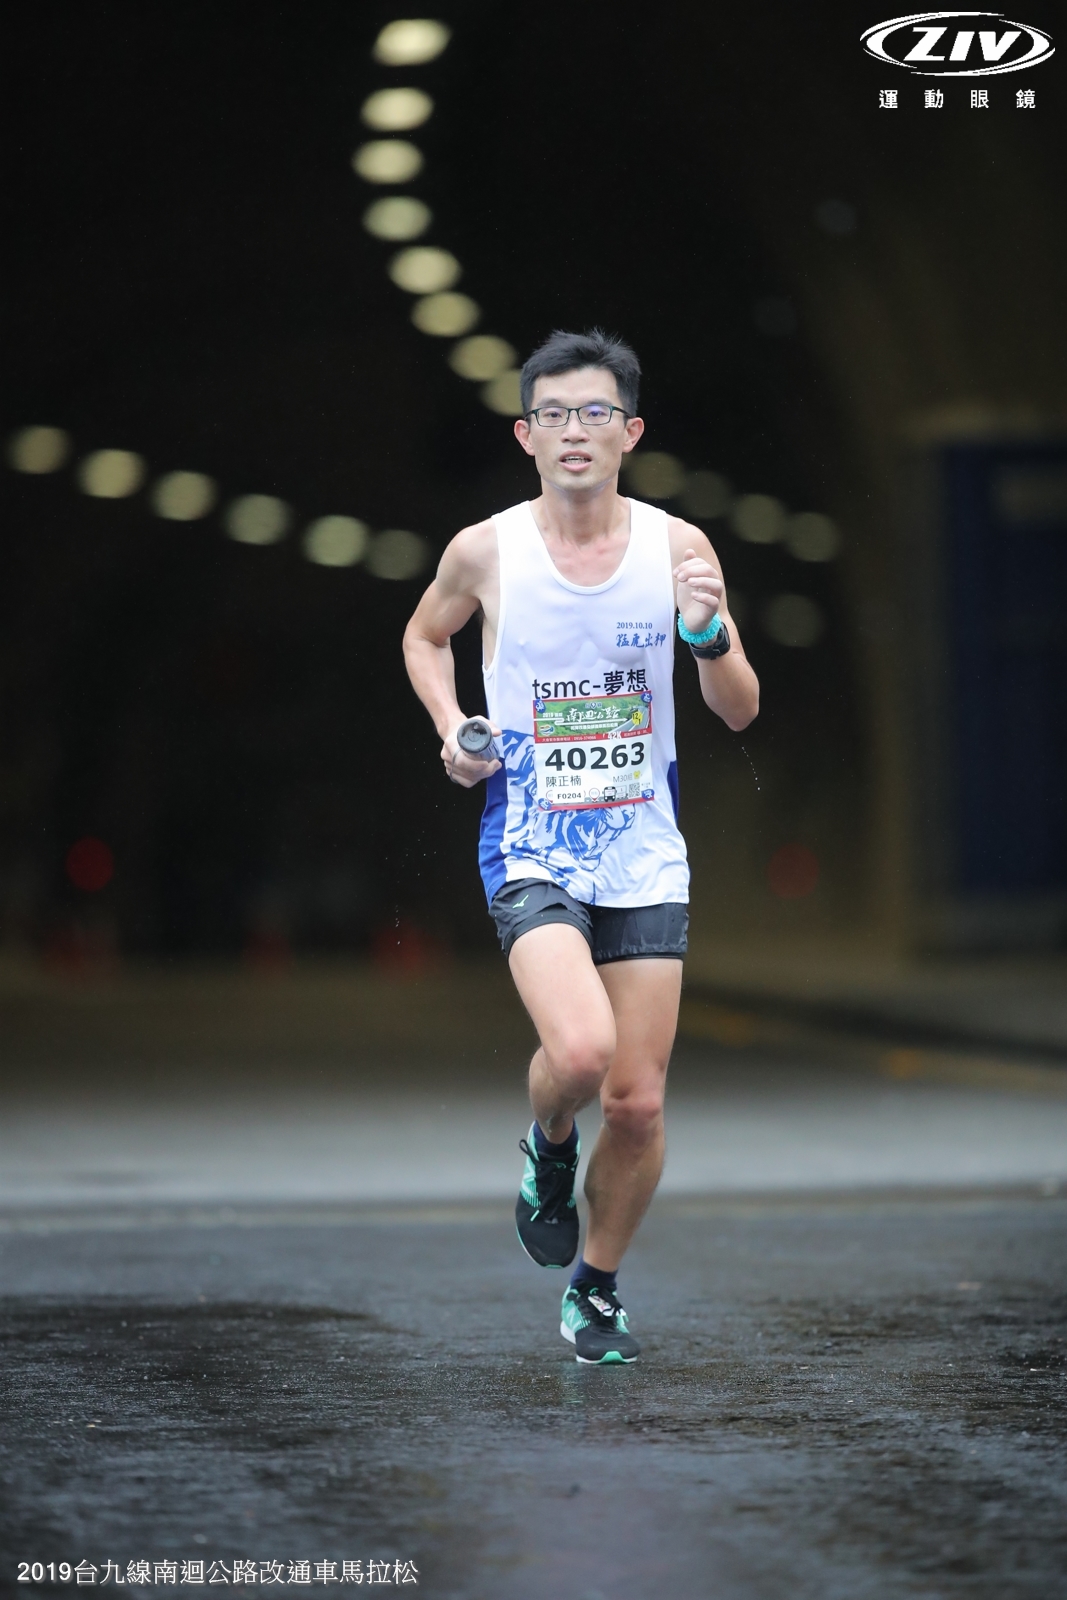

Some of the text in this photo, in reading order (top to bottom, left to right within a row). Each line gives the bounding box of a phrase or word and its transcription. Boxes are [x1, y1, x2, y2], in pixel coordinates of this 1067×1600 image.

[616, 621, 653, 630] 2019.10.10
[532, 669, 649, 699] tsmc-夢想
[545, 742, 645, 771] 40263
[545, 775, 582, 787] 陳正楠
